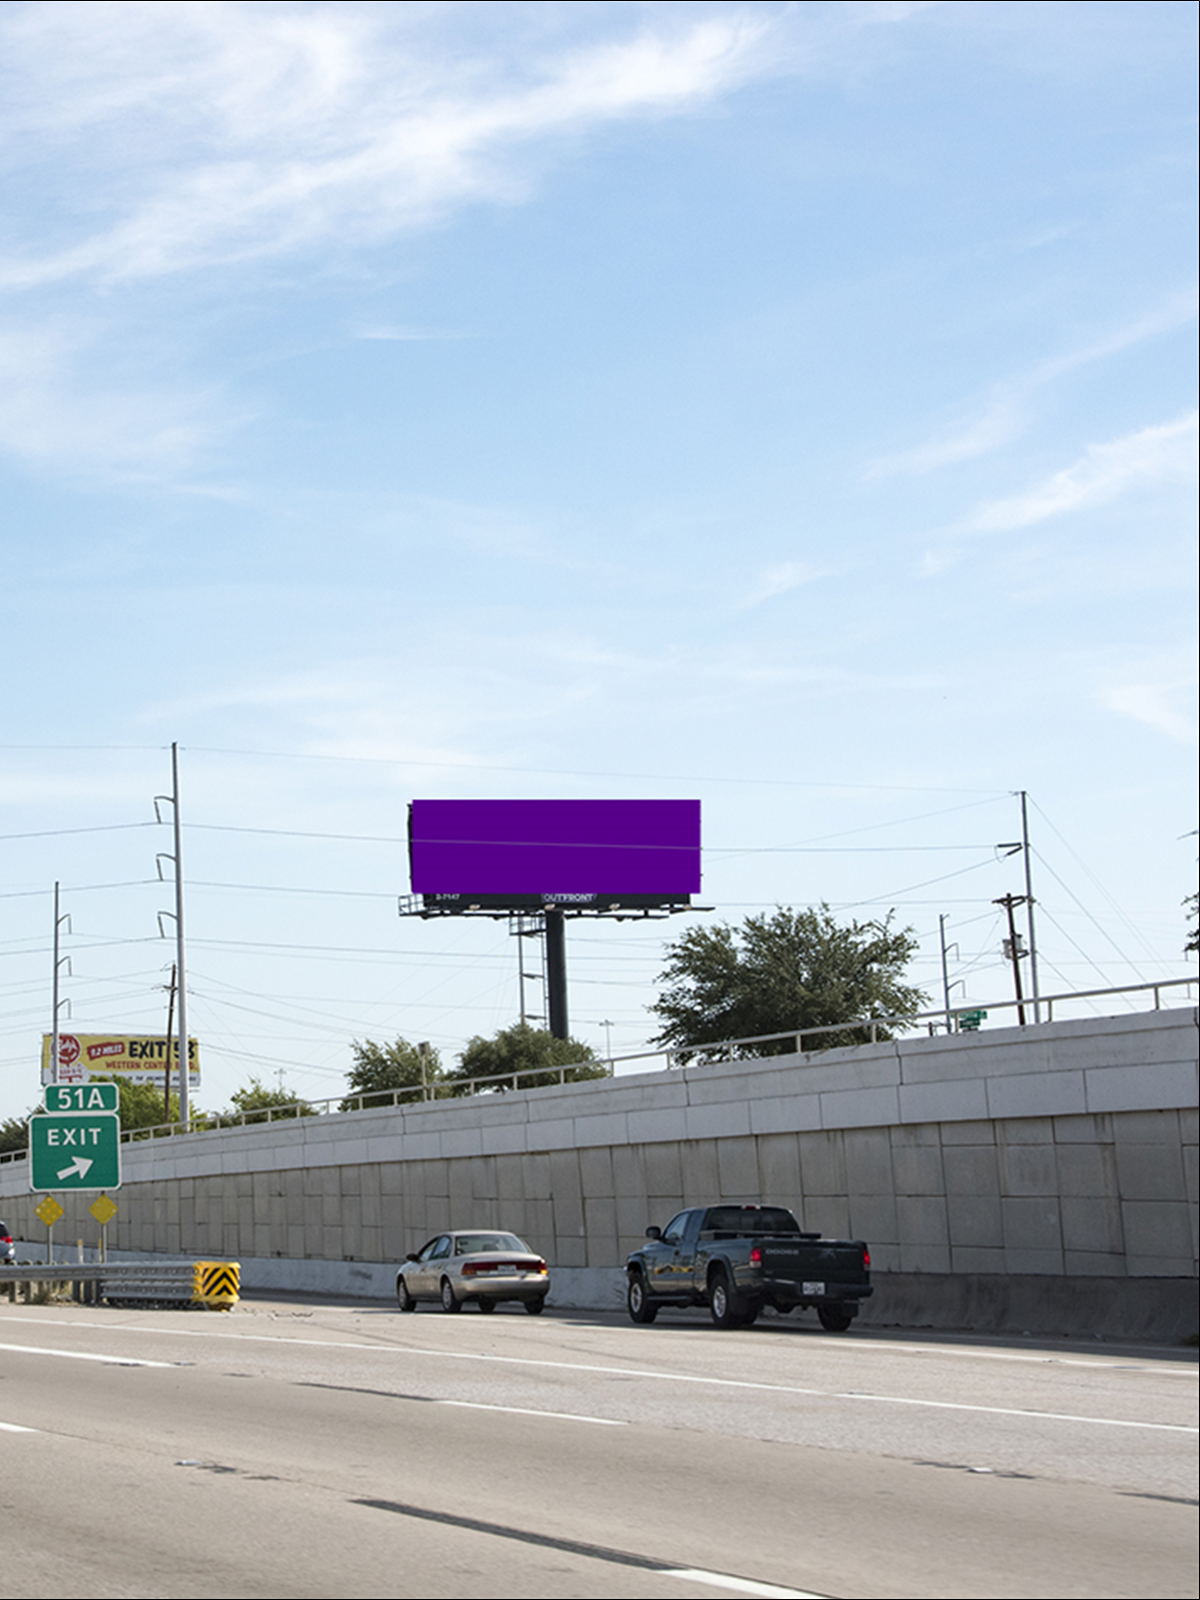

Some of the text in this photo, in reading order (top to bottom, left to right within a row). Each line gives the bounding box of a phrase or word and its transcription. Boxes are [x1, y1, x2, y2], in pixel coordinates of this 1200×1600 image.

[543, 893, 594, 902] OUTFRONT
[128, 1040, 166, 1059] EXIT
[105, 1061, 141, 1070] WESTERN
[143, 1061, 172, 1070] CENTE
[57, 1087, 105, 1109] 51A
[47, 1128, 102, 1146] EXIT
